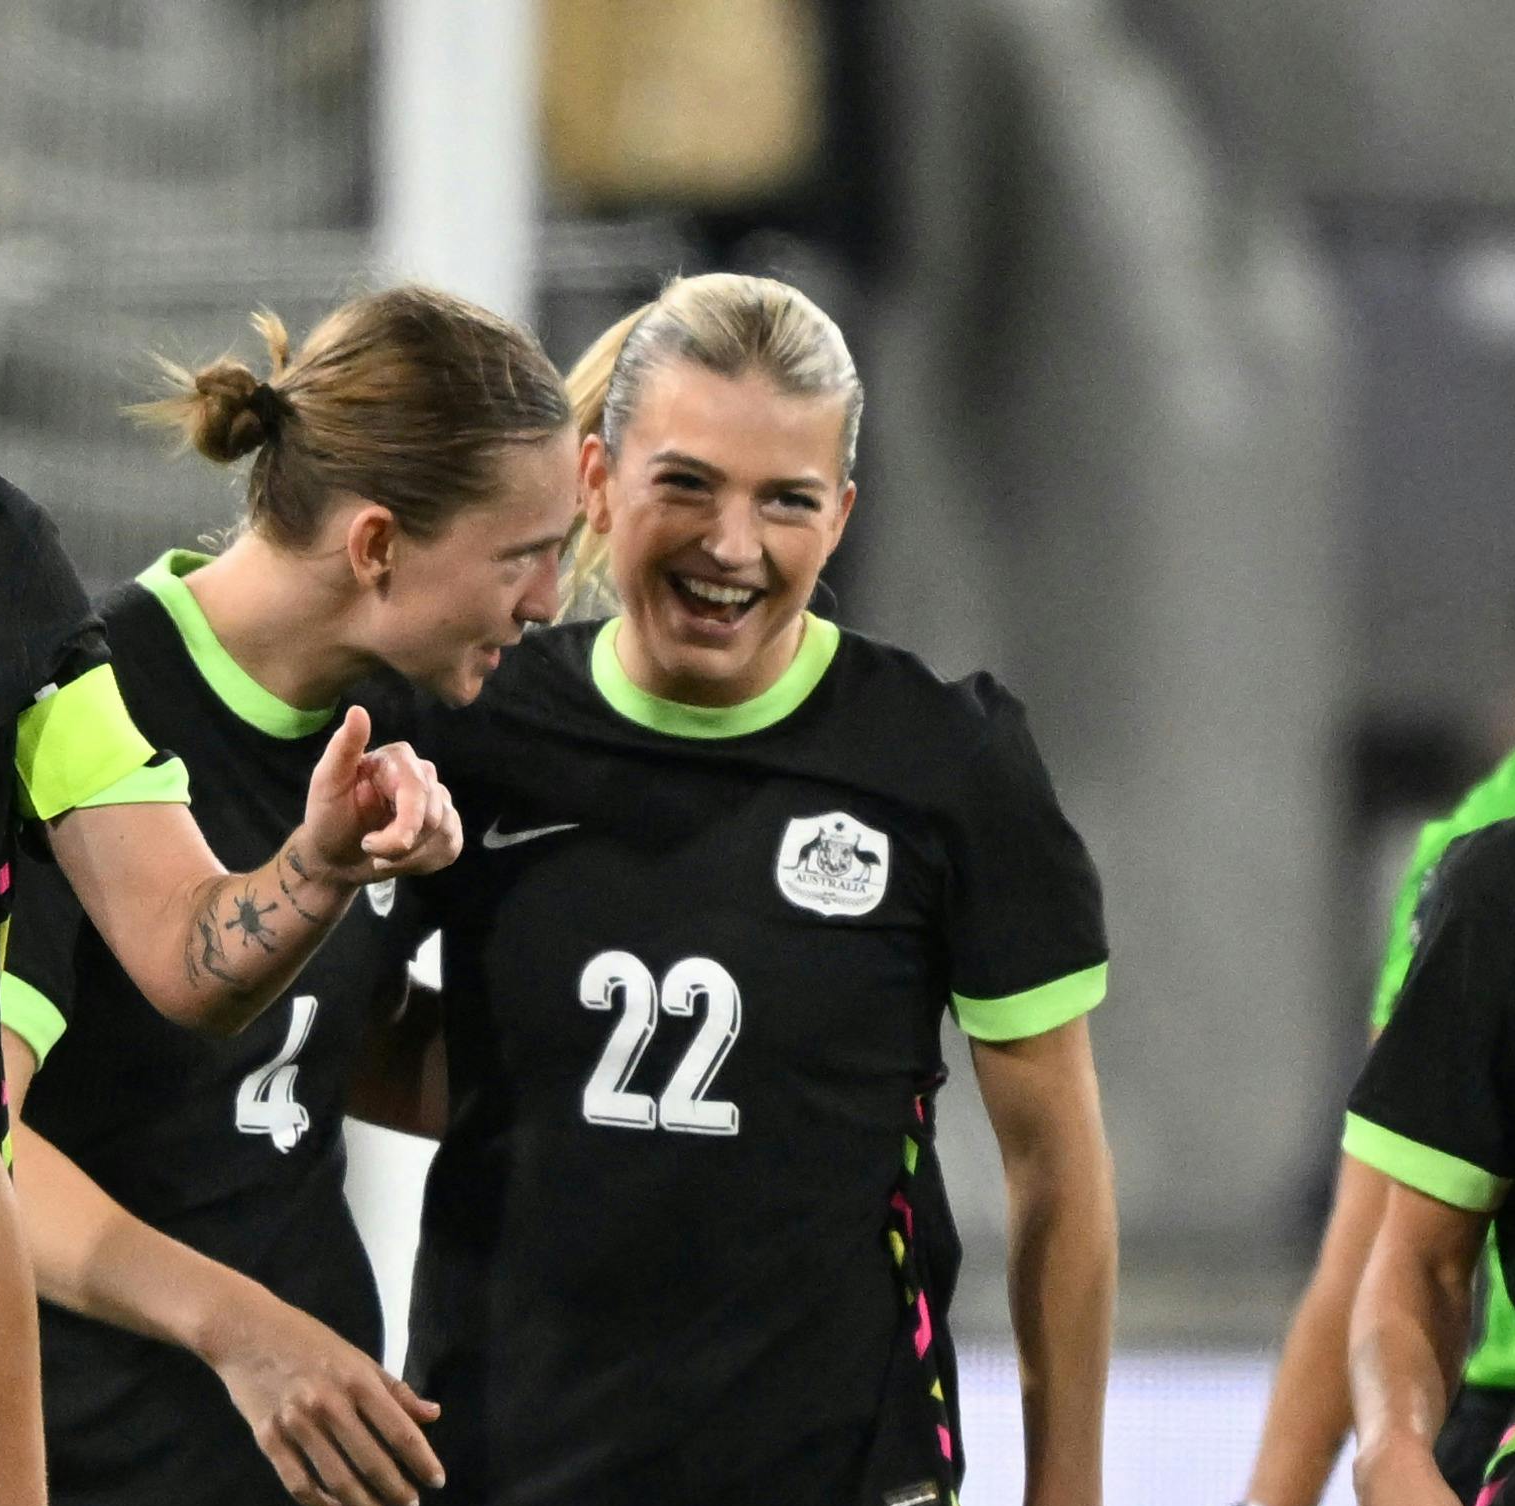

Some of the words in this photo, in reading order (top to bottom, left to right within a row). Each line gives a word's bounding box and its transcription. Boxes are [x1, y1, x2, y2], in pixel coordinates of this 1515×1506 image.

[796, 873, 867, 893] AUSTRALIA
[235, 995, 319, 1154] 4
[579, 950, 742, 1136] 22
